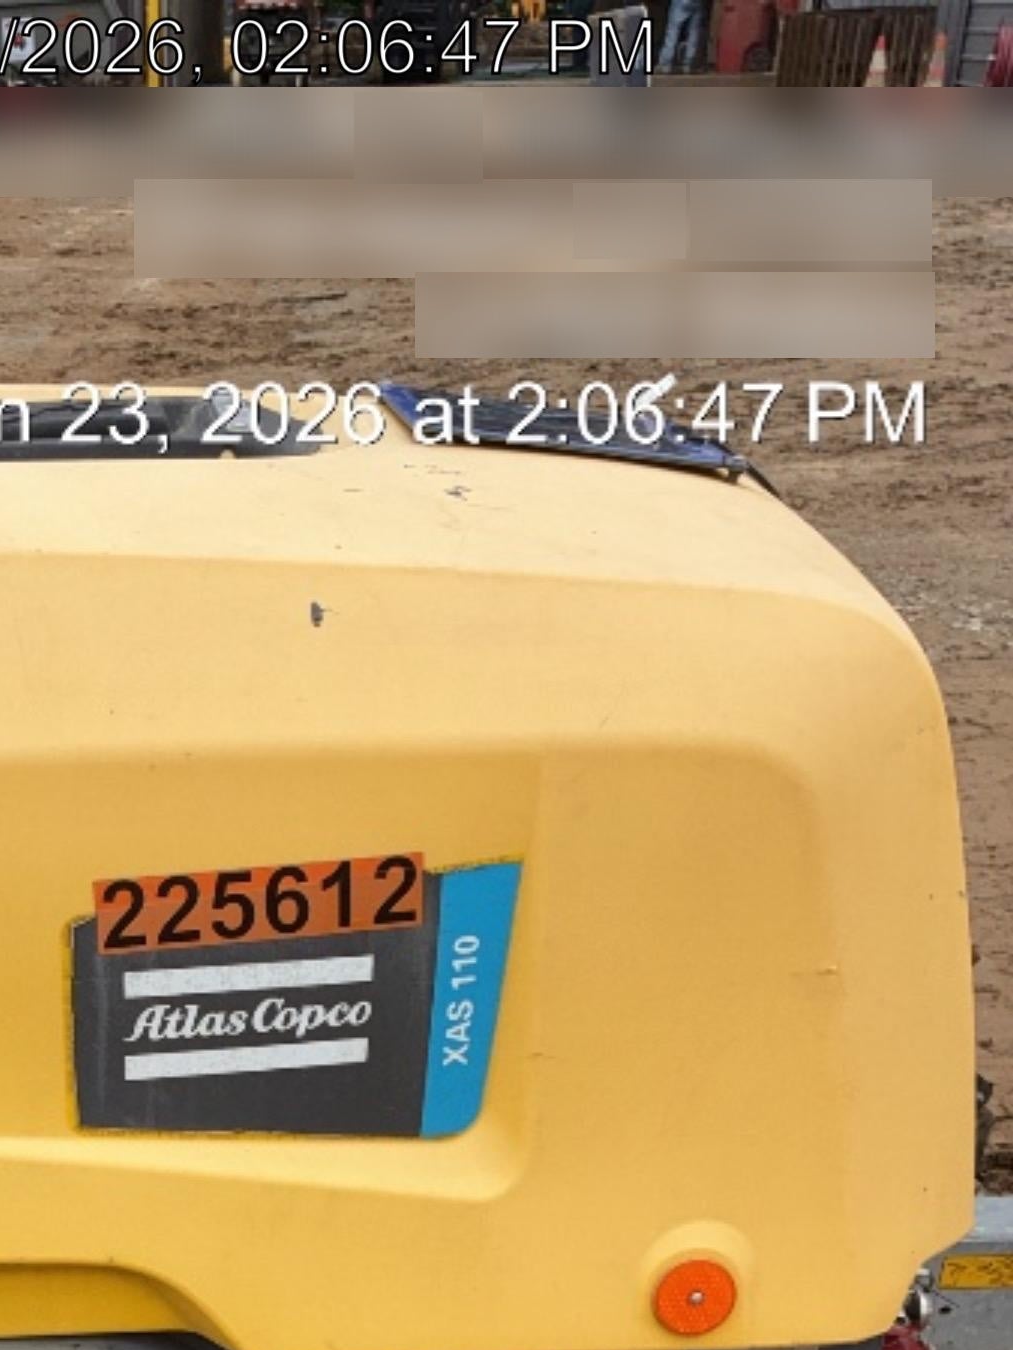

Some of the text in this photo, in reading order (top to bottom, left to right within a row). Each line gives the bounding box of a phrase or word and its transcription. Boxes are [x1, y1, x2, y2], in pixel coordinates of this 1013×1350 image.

[102, 854, 418, 950] 225612
[123, 997, 373, 1042] Atlas Copco
[442, 934, 481, 1067] XAS 110
